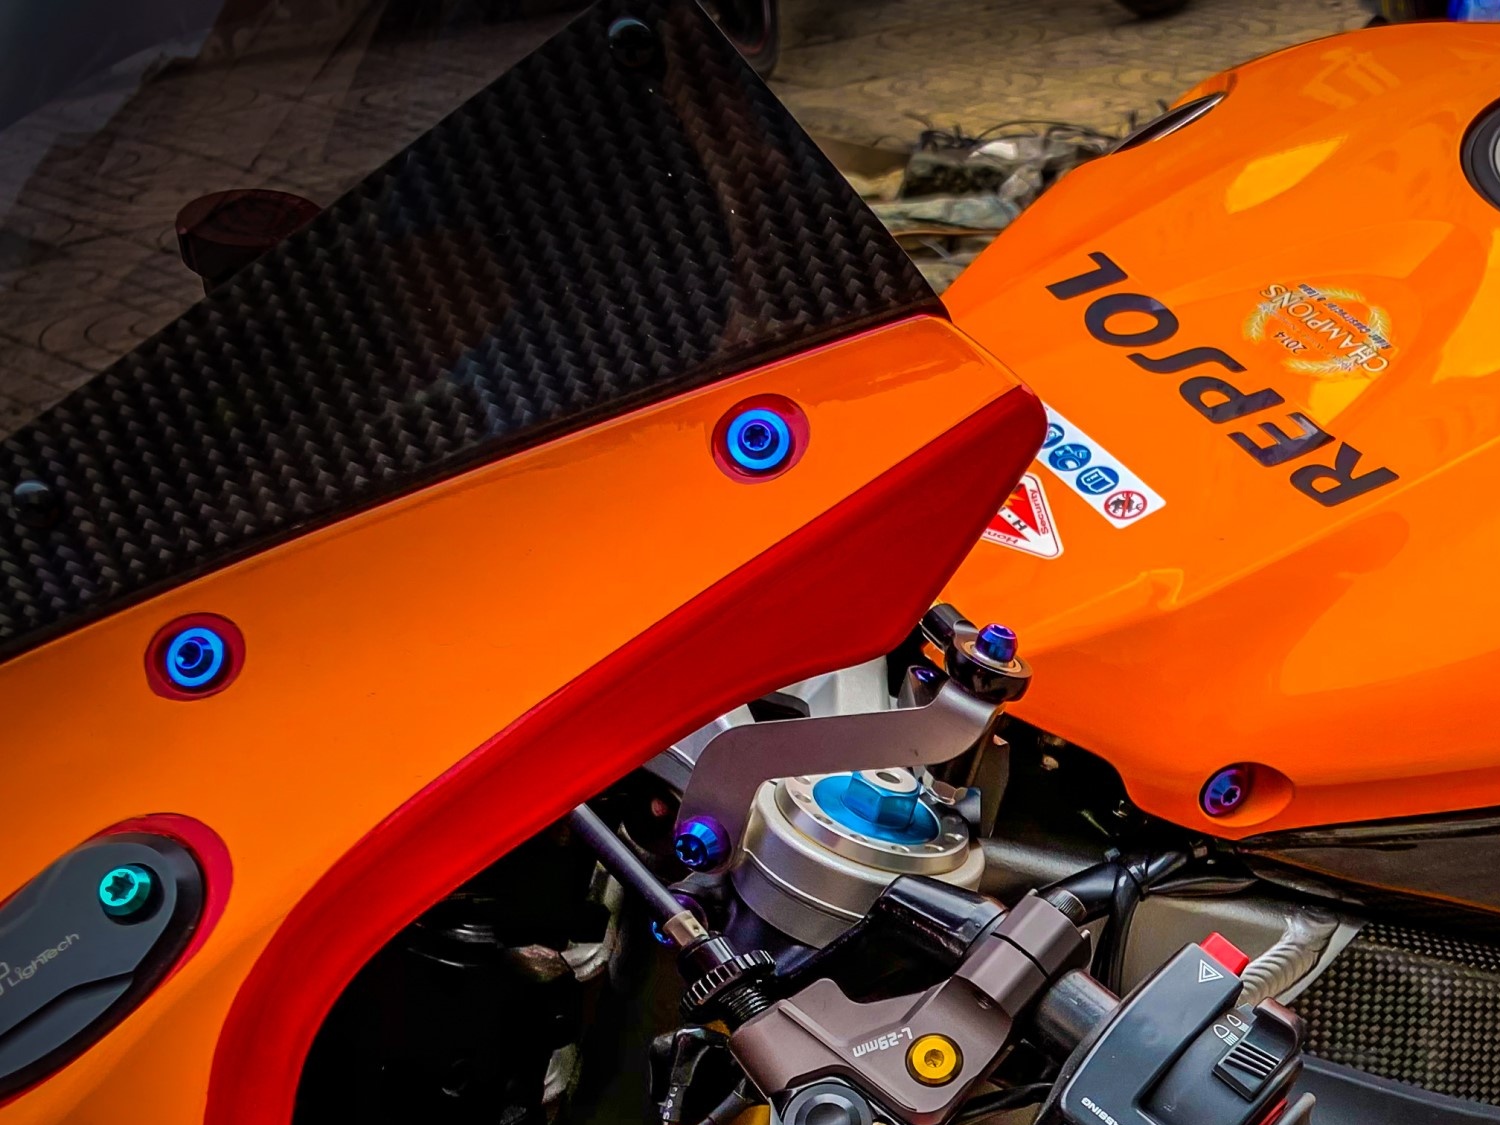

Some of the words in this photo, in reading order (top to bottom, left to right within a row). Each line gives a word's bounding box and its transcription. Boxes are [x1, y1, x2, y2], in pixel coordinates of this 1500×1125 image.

[1260, 283, 1390, 373] CHAMPIONS
[1275, 331, 1307, 353] 2014
[1045, 250, 1400, 508] REPSOL
[1029, 488, 1049, 535] Security
[852, 1026, 914, 1058] L-29mm
